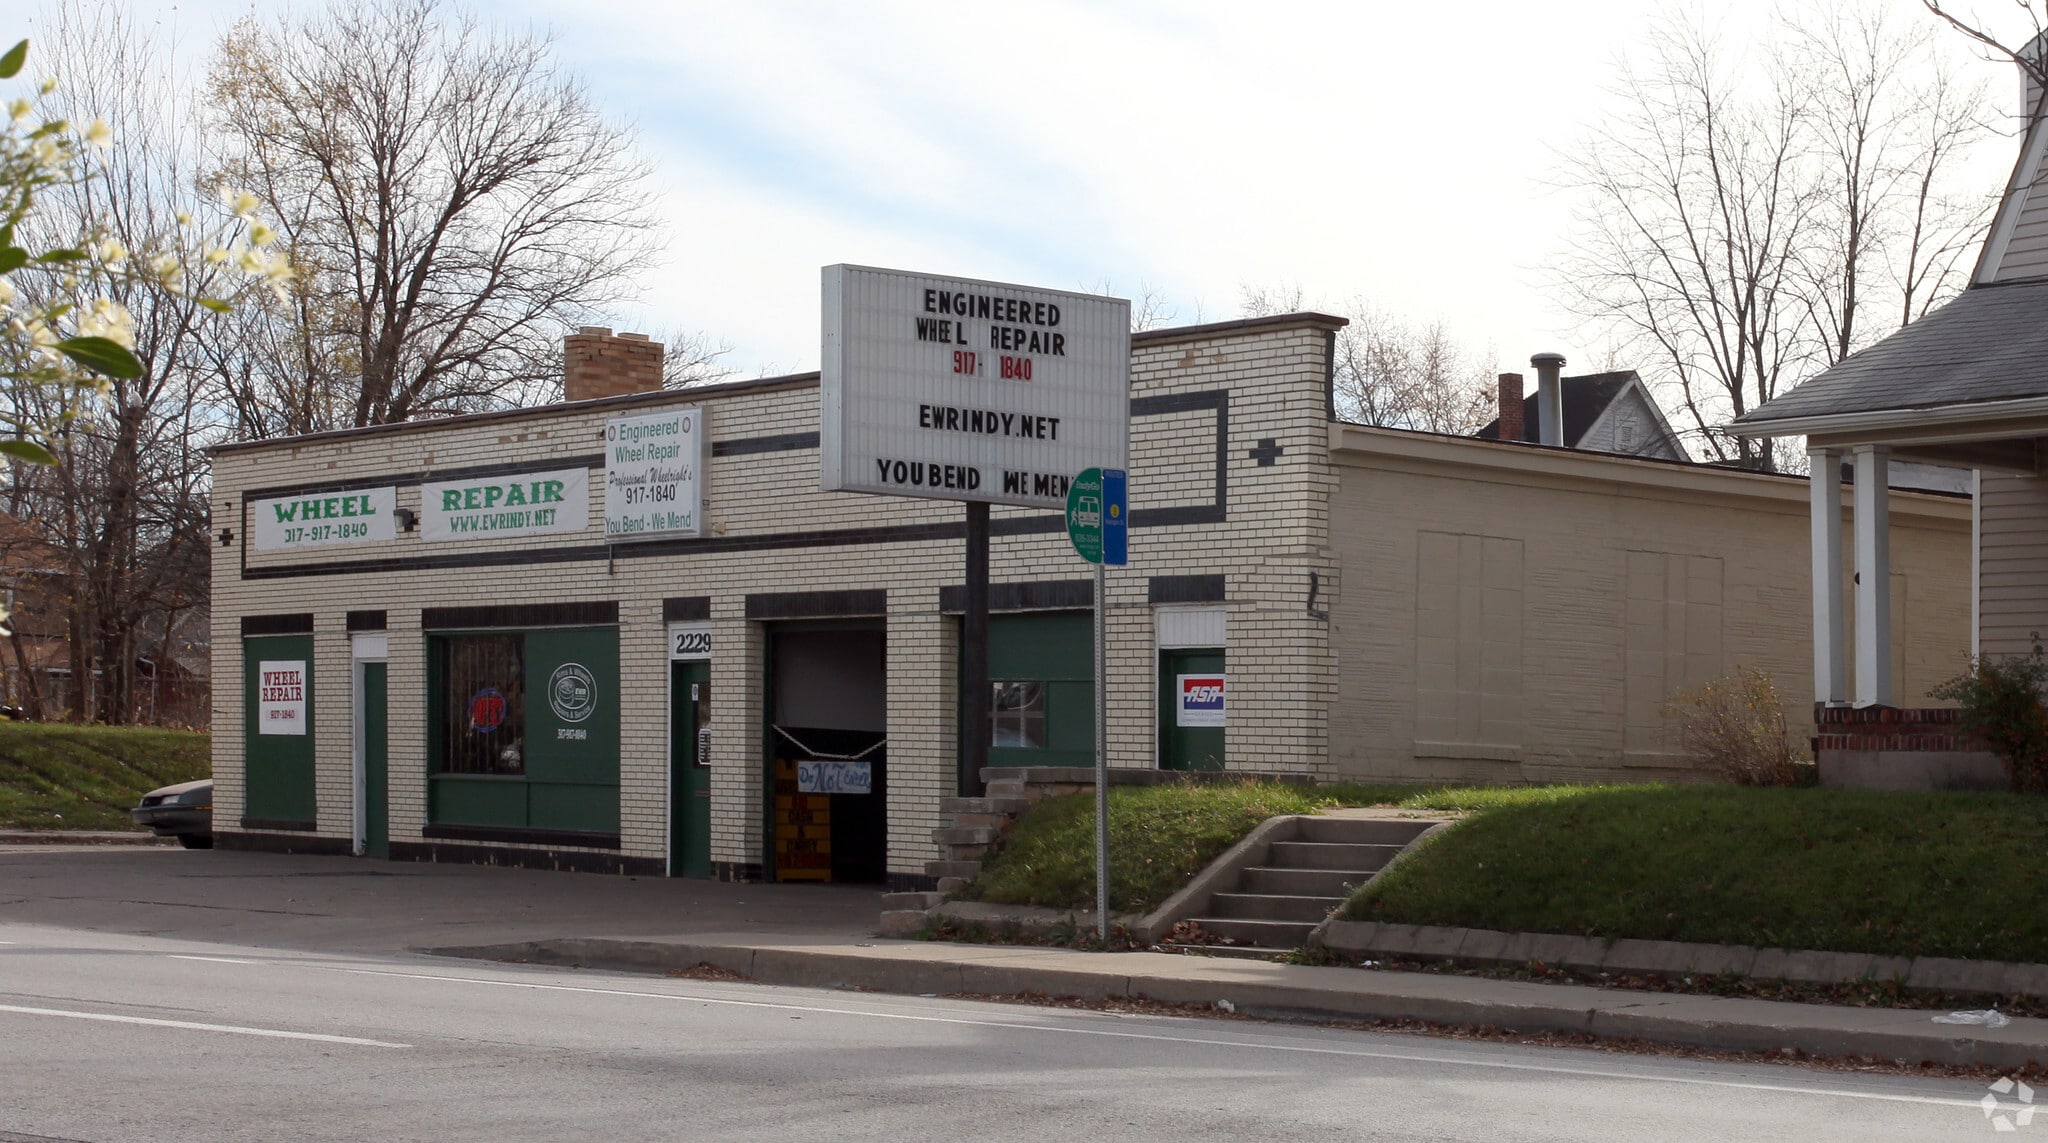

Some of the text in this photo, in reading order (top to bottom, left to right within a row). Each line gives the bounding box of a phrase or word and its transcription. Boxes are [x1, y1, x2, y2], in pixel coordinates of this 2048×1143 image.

[925, 288, 1061, 327] ENGINEERED
[916, 317, 1066, 356] WHEEL REPAIR
[999, 355, 1032, 381] 1840
[619, 417, 679, 444] Engineered
[919, 404, 1061, 441] EWRINDY.NET
[615, 441, 681, 463] Wheel Repair
[441, 480, 565, 512] REPAIR
[625, 484, 676, 504] 917-1840
[1003, 470, 1029, 495] WE
[1034, 473, 1075, 499] MEN
[273, 494, 377, 524] WHEEL
[450, 508, 557, 533] WWW.EWRINDY.NET
[284, 522, 368, 543] 317-917-1840
[605, 517, 620, 534] You
[623, 514, 645, 532] Bend
[651, 513, 665, 530] We
[667, 511, 692, 529] Mend
[676, 633, 711, 654] 2229
[263, 670, 302, 686] WHEEL
[262, 687, 303, 702] REPAIR
